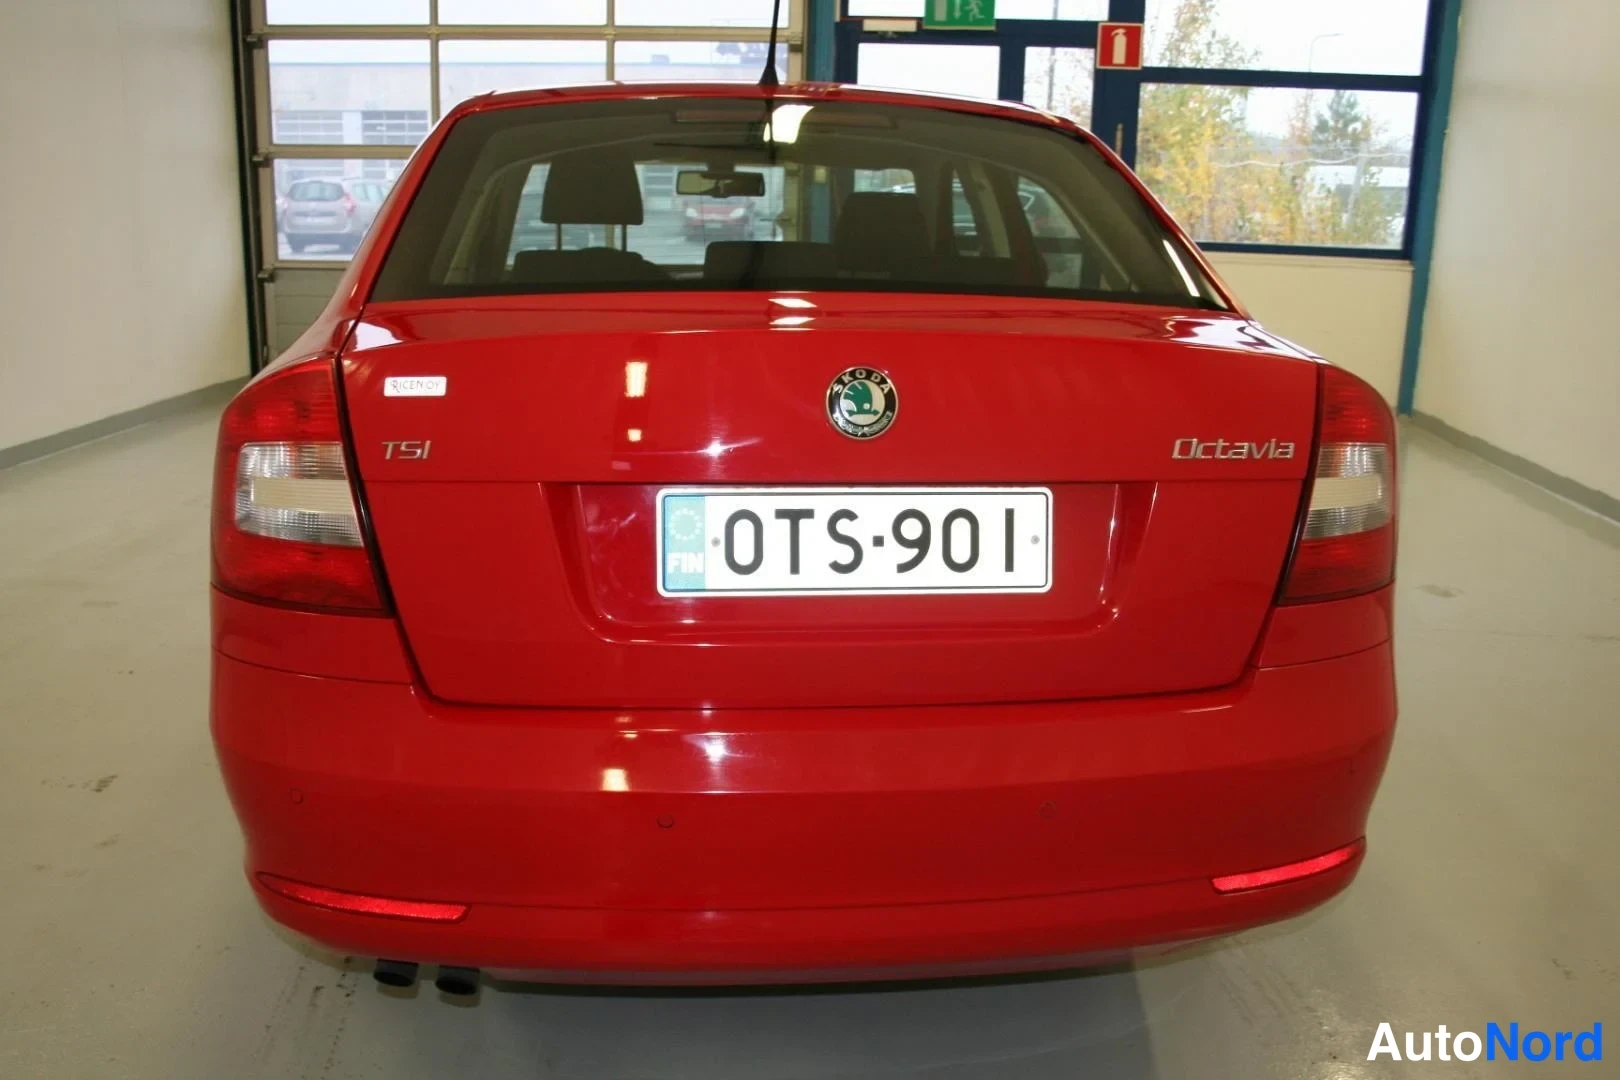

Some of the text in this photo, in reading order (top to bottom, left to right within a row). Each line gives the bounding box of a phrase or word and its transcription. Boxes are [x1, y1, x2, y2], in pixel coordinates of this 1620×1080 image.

[381, 440, 431, 460] TSI
[1171, 438, 1296, 460] Octavia
[724, 507, 1015, 576] OTS-901
[667, 551, 705, 574] FIN
